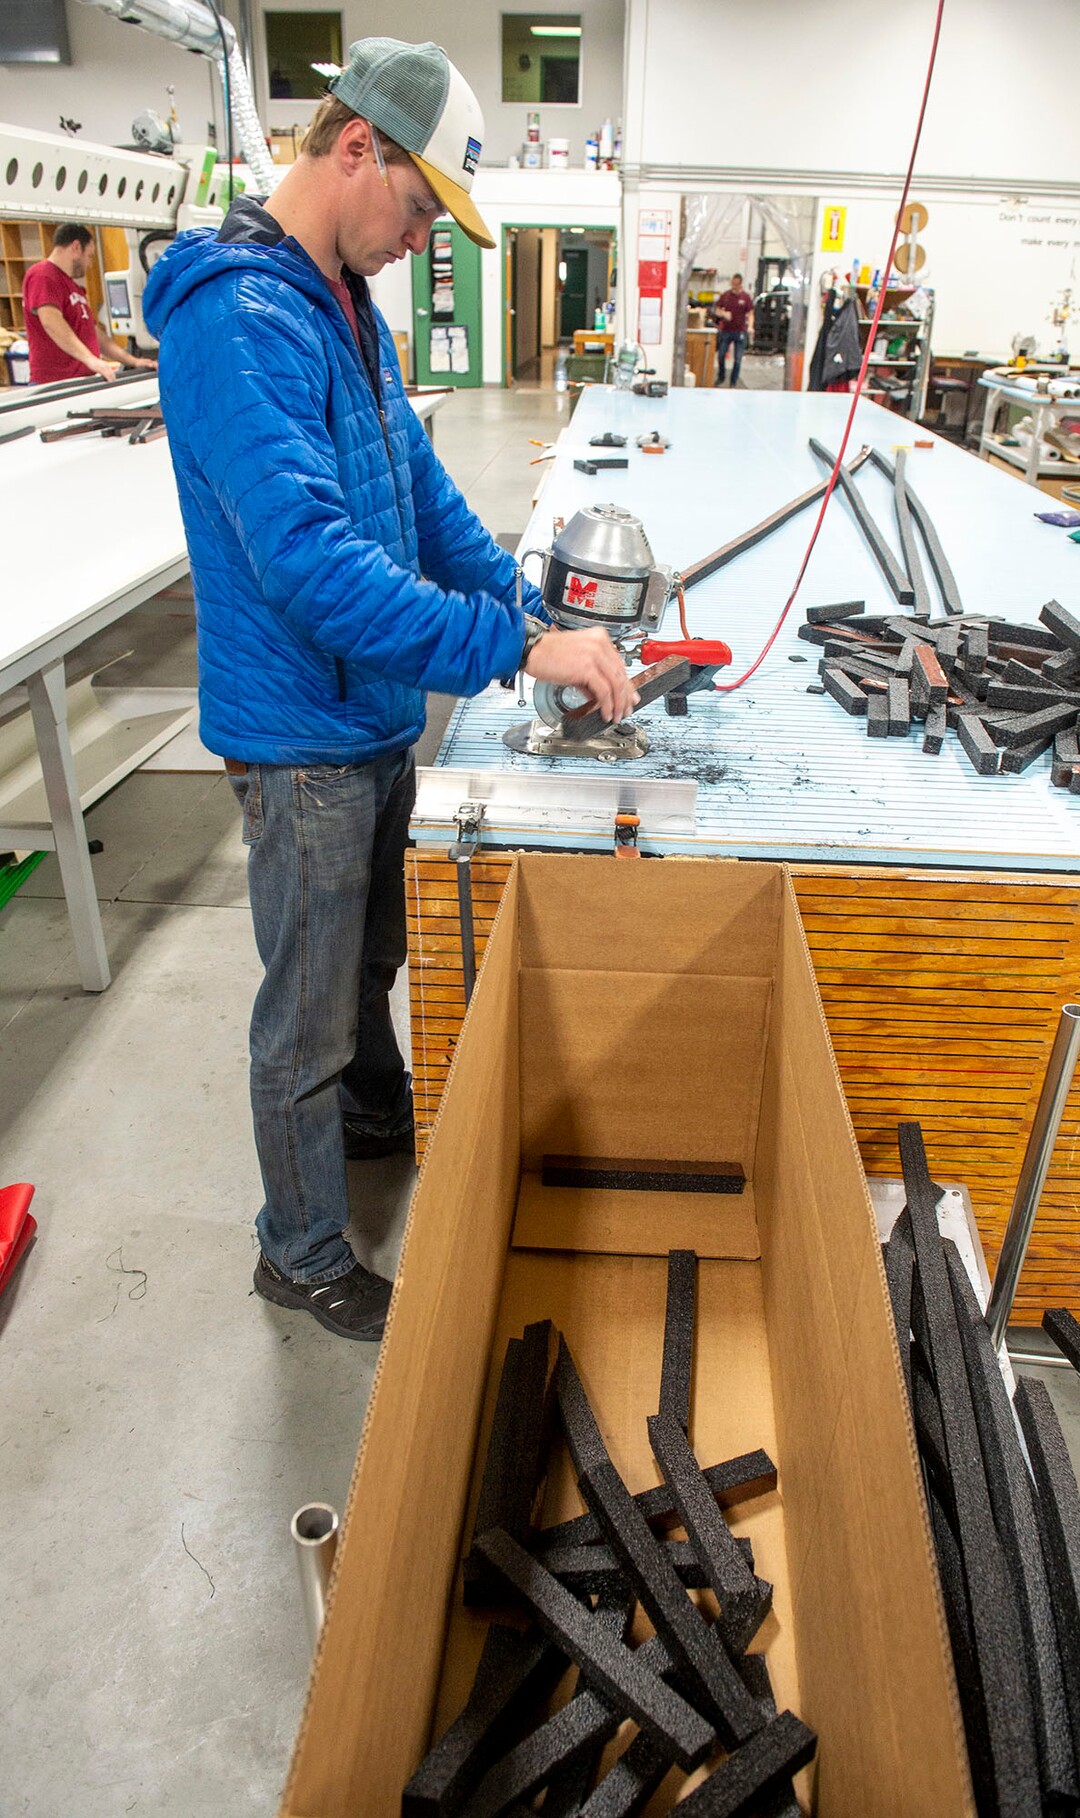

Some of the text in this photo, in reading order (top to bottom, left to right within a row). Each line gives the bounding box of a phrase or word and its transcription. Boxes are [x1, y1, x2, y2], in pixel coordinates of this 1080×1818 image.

[999, 212, 1077, 226] Don't count every
[1047, 240, 1068, 249] every
